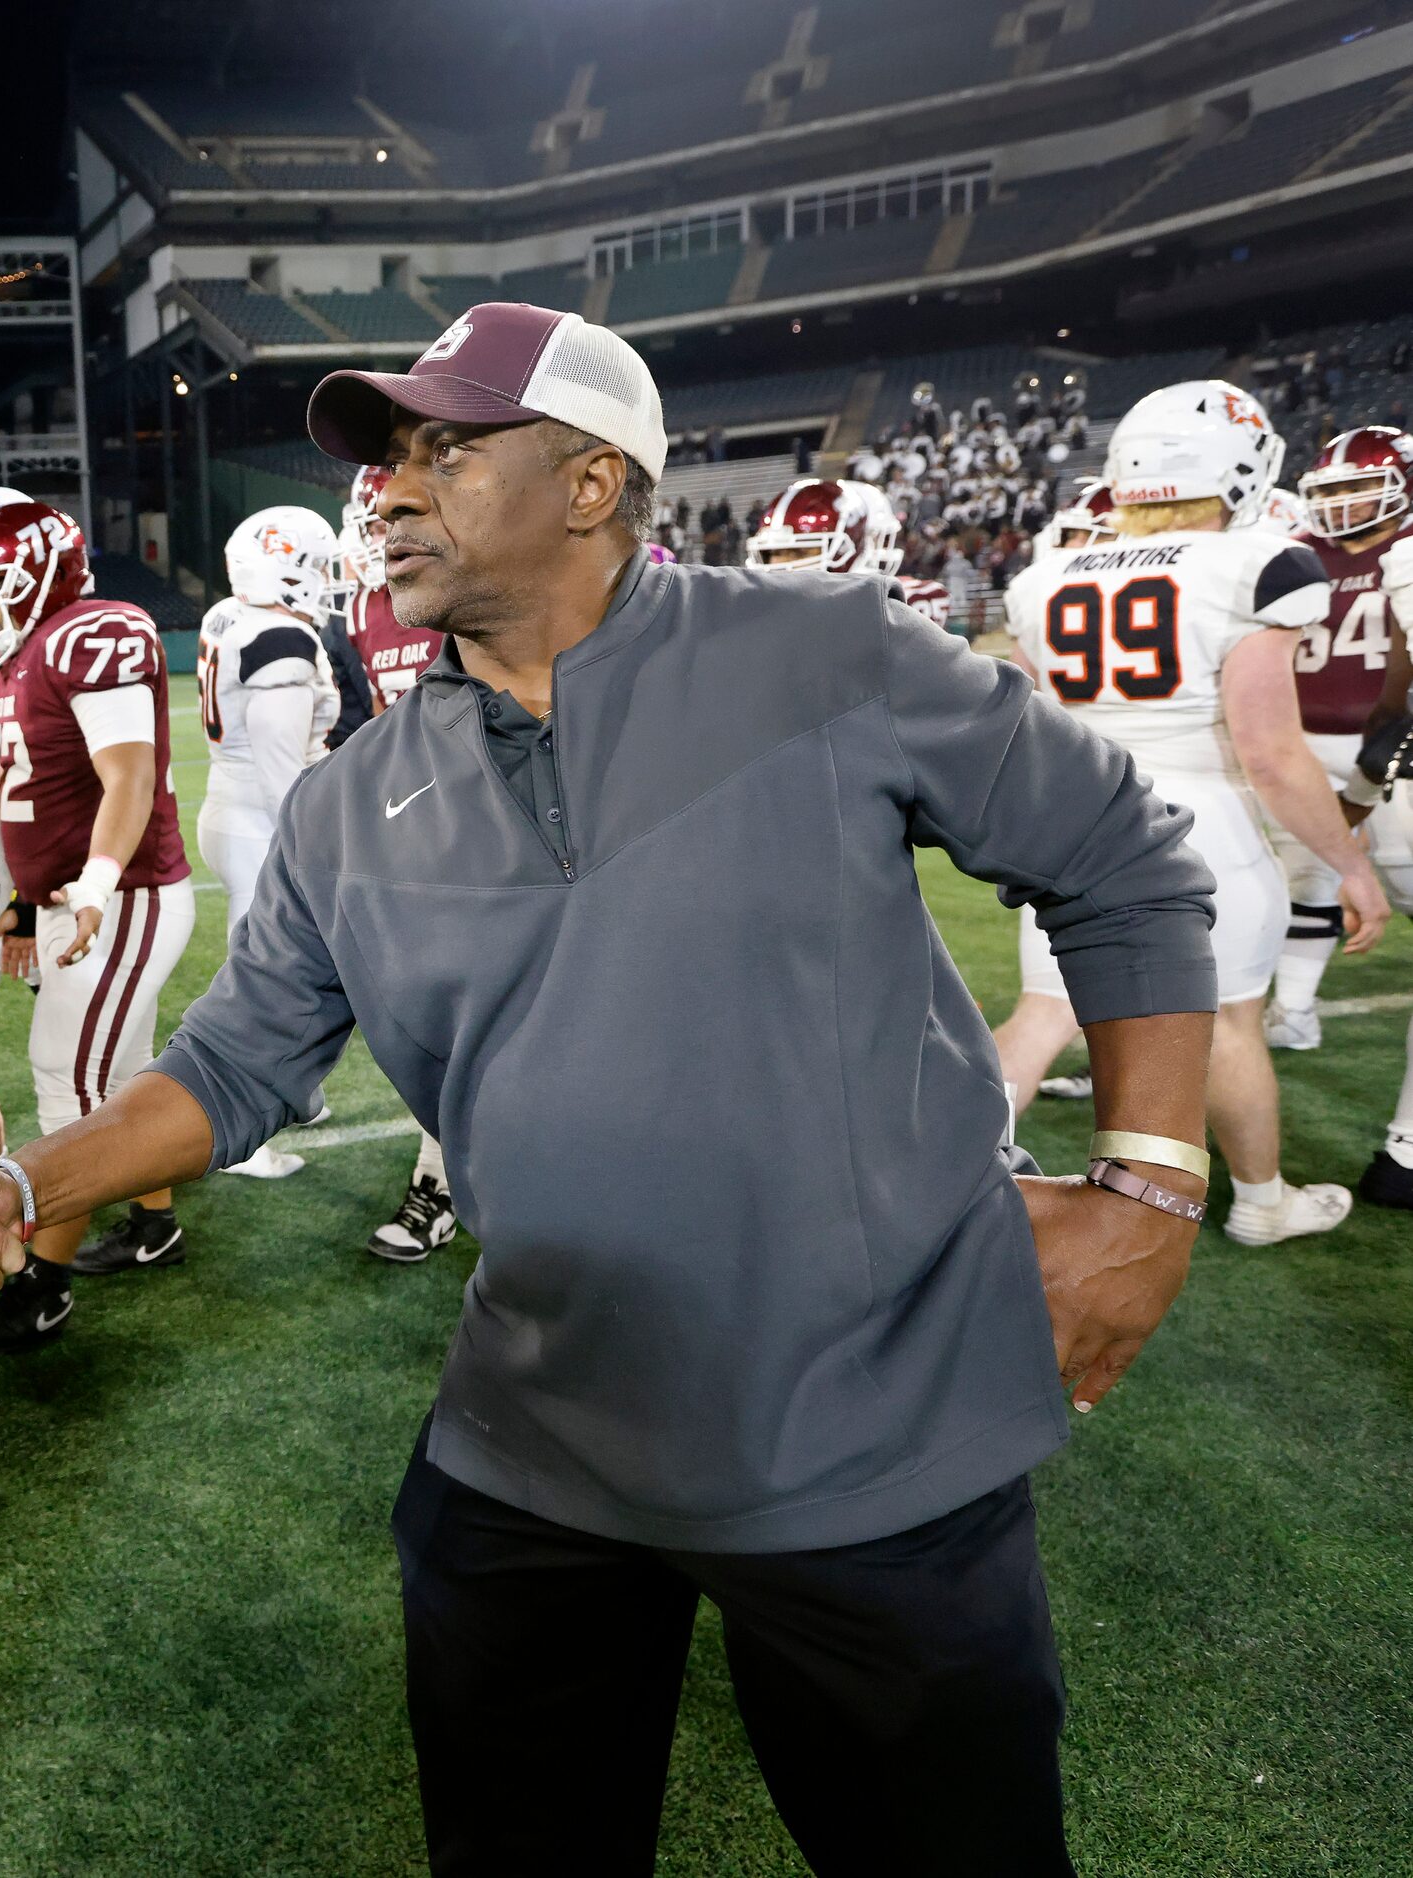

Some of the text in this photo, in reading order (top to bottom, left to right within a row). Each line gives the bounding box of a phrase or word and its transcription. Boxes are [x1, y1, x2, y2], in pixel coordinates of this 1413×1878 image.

[15, 515, 75, 565] 72
[1063, 543, 1193, 575] MCINTIRE
[82, 636, 147, 684] 72
[371, 640, 431, 671] RED OAK
[1046, 575, 1183, 703] 99
[23, 1183, 35, 1220] ROISD
